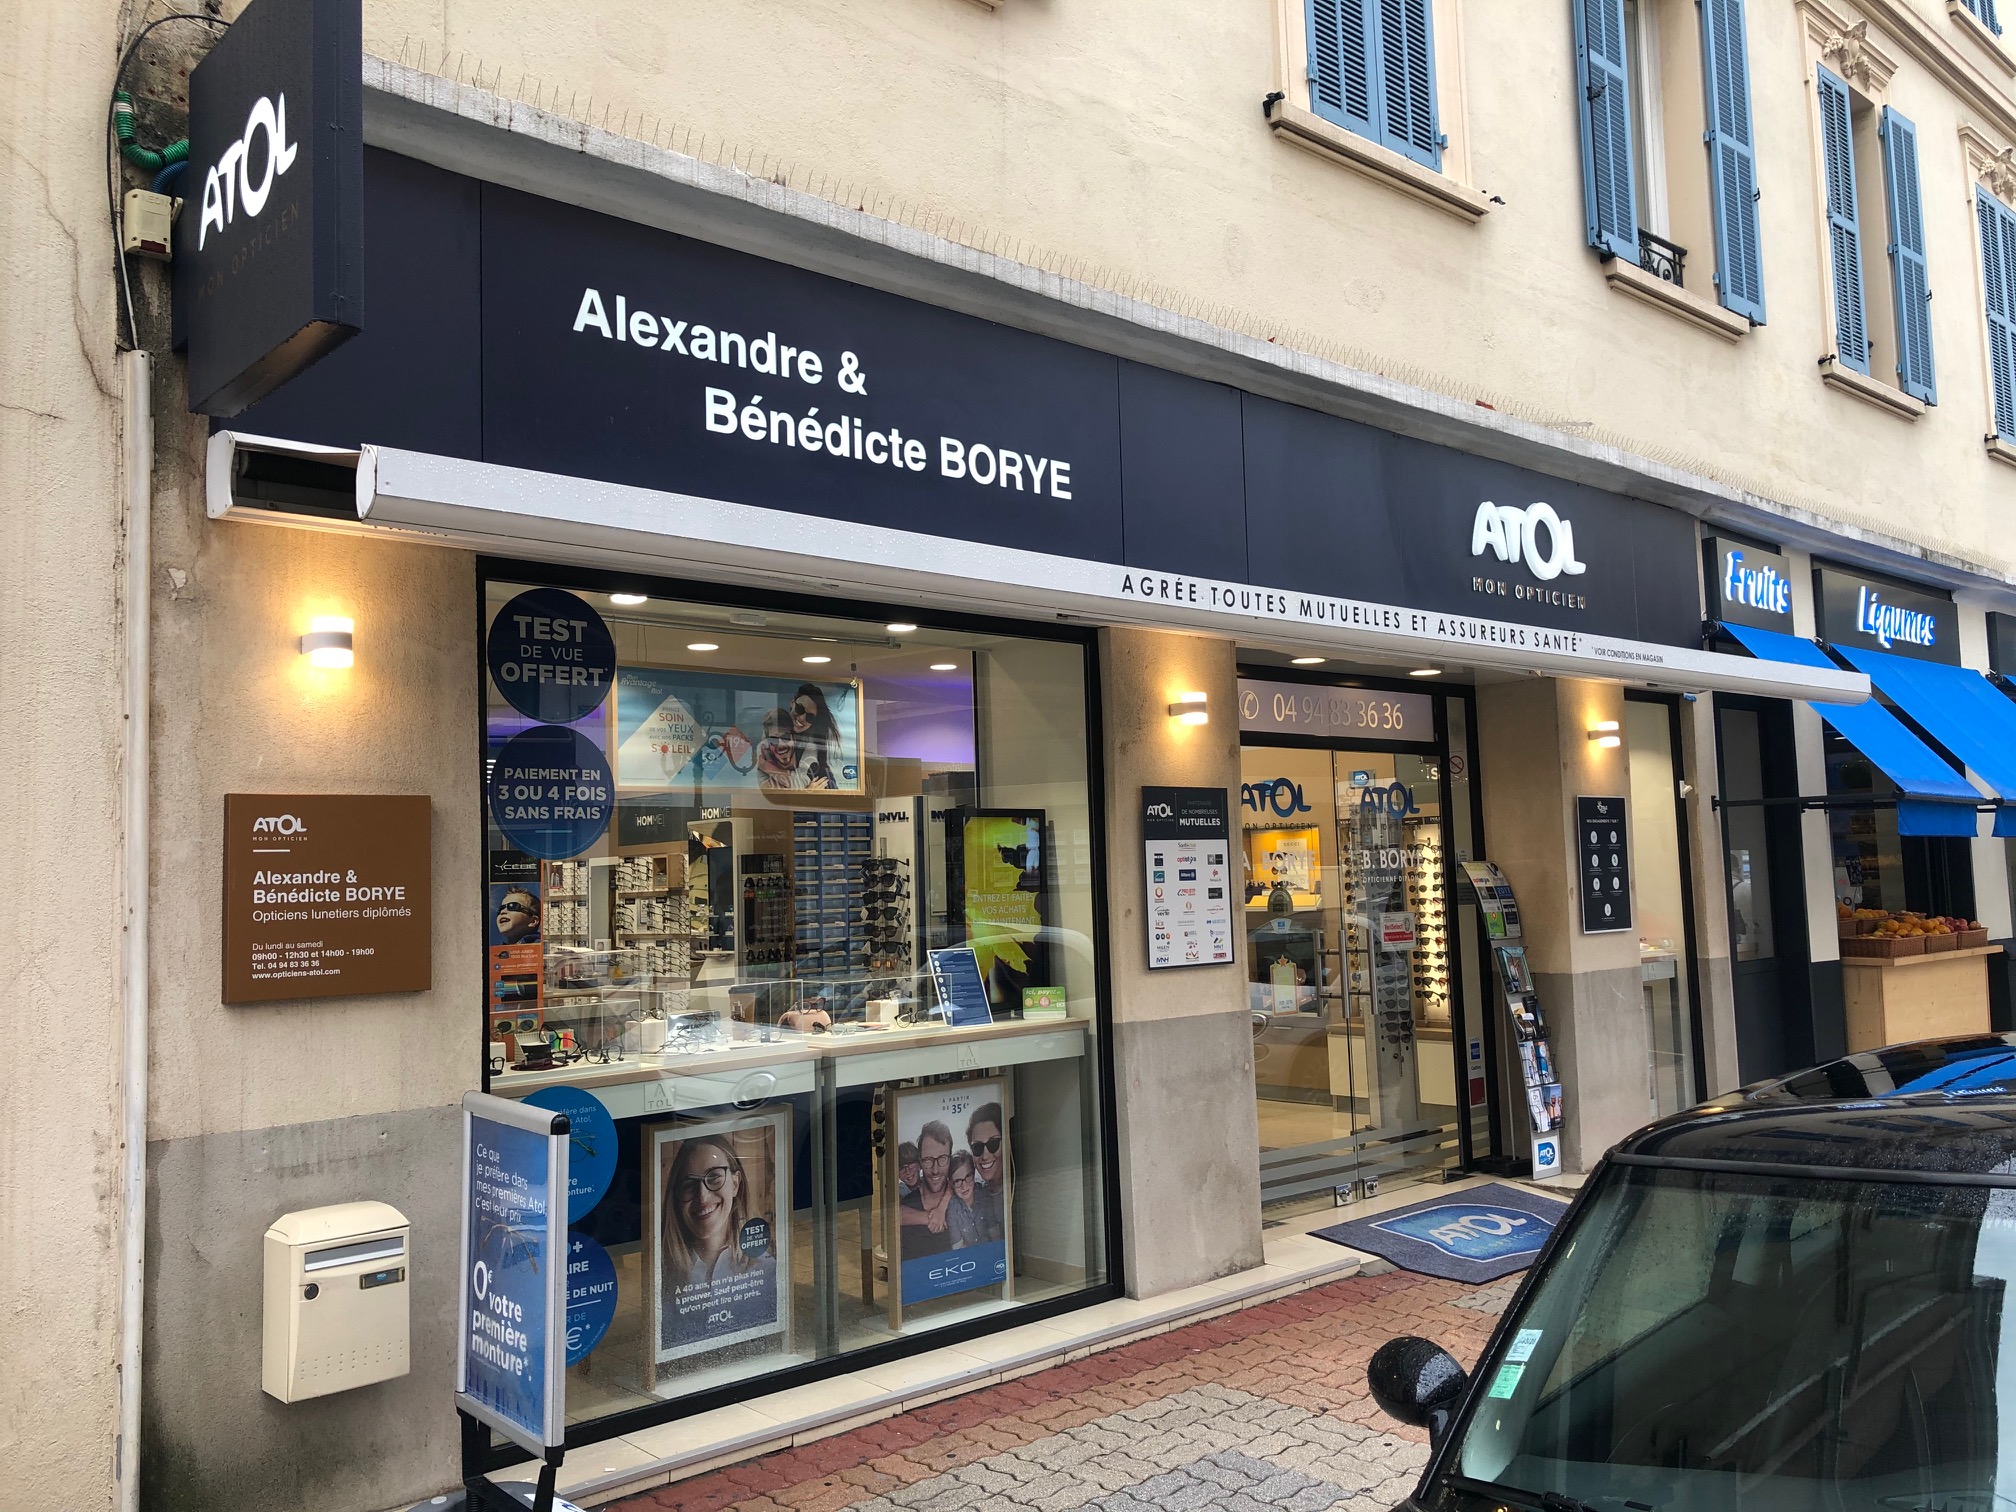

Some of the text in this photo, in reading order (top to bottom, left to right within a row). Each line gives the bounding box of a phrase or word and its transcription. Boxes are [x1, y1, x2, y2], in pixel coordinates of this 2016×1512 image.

[199, 92, 298, 251] ATOL
[231, 203, 299, 274] OPTICIEN
[573, 288, 868, 396] Alexandre &
[705, 386, 1072, 500] Bénédicte BORYE
[1472, 501, 1587, 580] ATOL
[1725, 551, 1790, 614] Fruits
[1472, 576, 1586, 610] MON OPTICIEN
[1121, 574, 1197, 602] AGRÉE
[1211, 586, 1286, 614] TOUTES
[1299, 600, 1400, 629] MUTUELLES
[1412, 614, 1427, 632] ET
[1438, 618, 1525, 646] ASSUREURS
[1857, 586, 1936, 649] Légumes
[513, 615, 588, 643] TEST
[520, 644, 584, 661] DE VUE
[1607, 648, 1635, 661] CONDITIONS
[1635, 652, 1642, 661] EN
[1642, 653, 1664, 663] MAGASIN
[659, 713, 684, 722] SOIN
[1273, 693, 1403, 729] 04 94 83 36 36
[667, 724, 694, 733] YEUX
[504, 768, 600, 780] PAIEMENT EN
[498, 785, 607, 800] 3 OU 4 FOIS
[1241, 777, 1312, 818] ATOL
[1360, 782, 1420, 820] ATOL
[505, 806, 550, 819] SANS
[702, 806, 730, 819] HOMME
[1147, 803, 1173, 817] ATOL
[253, 814, 307, 835] ATOL
[636, 814, 663, 827] HOMME
[1180, 818, 1220, 826] MUTUELLES
[1262, 850, 1315, 870] BORYE
[1363, 850, 1424, 869] B. BORYE
[253, 869, 358, 885] Alexandre &
[253, 886, 406, 904] Bénédicte BORYE
[973, 893, 1034, 902] ENTREZ ET FAITES
[252, 907, 412, 924] Opticiens lunetiers diplômés
[982, 905, 1026, 914] VOS ACHATS
[990, 917, 1035, 925] MAINTENANT
[265, 942, 283, 950] lundi
[296, 941, 323, 949] samedi
[252, 953, 277, 961] 09h00
[285, 951, 309, 959] 12h30
[321, 949, 344, 957] 14h00
[351, 948, 374, 956] 19h00
[300, 960, 309, 968] 36
[311, 960, 320, 968] 36
[252, 968, 340, 979] www.opticiens-atol.com
[654, 1084, 666, 1097] A
[579, 1105, 596, 1114] dans
[648, 1099, 671, 1109] TOL
[476, 1143, 500, 1163] Ce que
[1540, 1148, 1554, 1159] ATOL
[476, 1161, 528, 1190] je préfère dans
[475, 1195, 491, 1213] c'est
[492, 1203, 509, 1218] leur
[476, 1180, 547, 1217] mes premières Atol,
[745, 1224, 764, 1235] TEST
[1428, 1213, 1528, 1246] ATOL
[929, 1261, 976, 1280] EKO
[573, 1281, 614, 1298] DE NUIT
[675, 1285, 681, 1294] À
[682, 1284, 694, 1292] 40
[694, 1281, 709, 1290] ans,
[722, 1275, 733, 1284] n'a
[734, 1271, 749, 1282] plus
[750, 1268, 764, 1277] rien
[675, 1279, 764, 1305] à prouver. Sauf peut-être
[489, 1292, 522, 1322] votre
[680, 1303, 700, 1314] qu'on
[701, 1299, 719, 1311] peut
[574, 1311, 586, 1321] DE
[708, 1310, 734, 1323] ATOL
[472, 1309, 527, 1352] première
